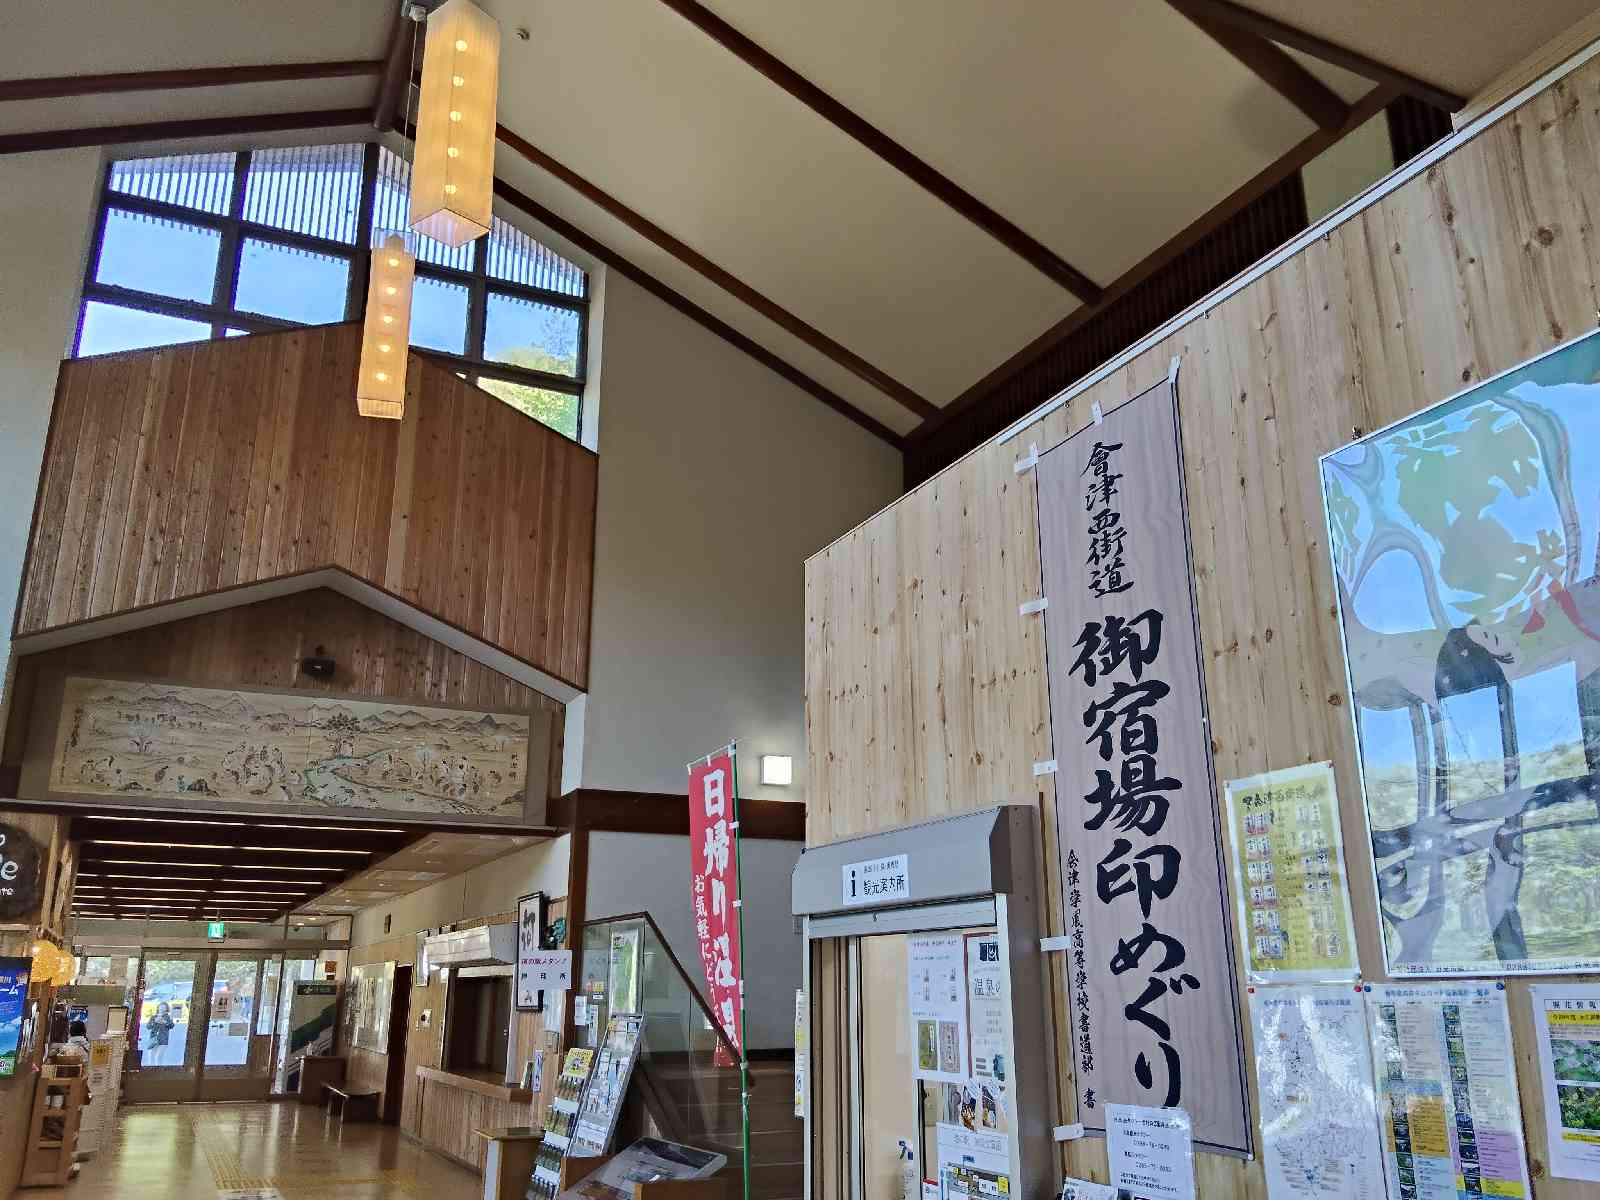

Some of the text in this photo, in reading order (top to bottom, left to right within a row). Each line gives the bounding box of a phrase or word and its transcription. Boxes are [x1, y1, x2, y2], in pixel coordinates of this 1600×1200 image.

[1080, 441, 1134, 598] 會津西街道
[1068, 609, 1201, 1108] 御宿場印めぐり
